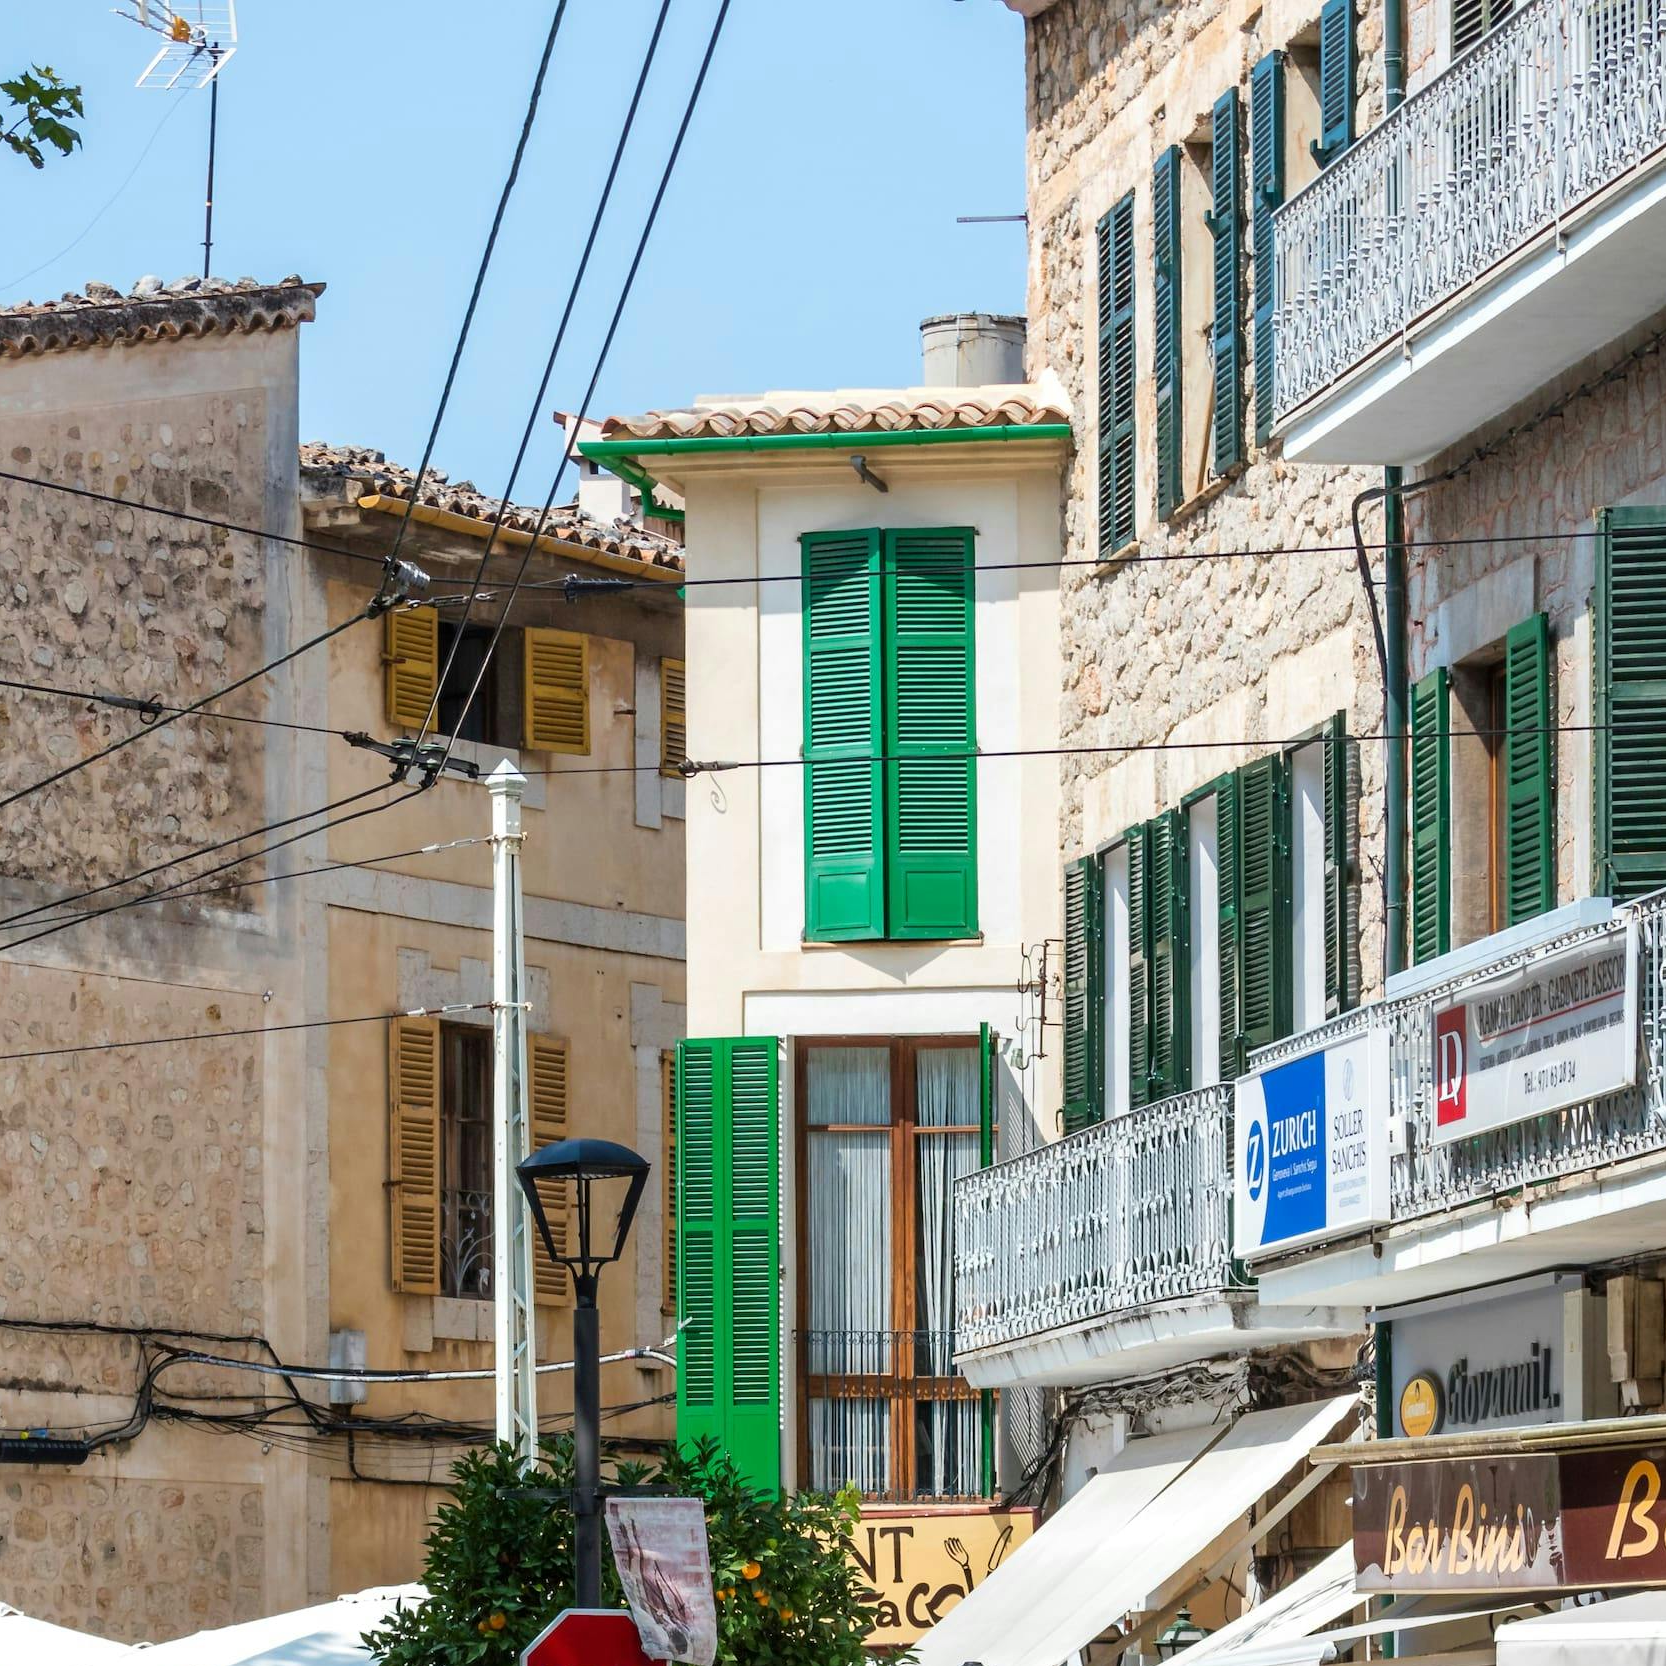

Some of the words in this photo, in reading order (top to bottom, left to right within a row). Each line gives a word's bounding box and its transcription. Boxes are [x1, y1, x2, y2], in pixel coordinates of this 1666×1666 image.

[1548, 967, 1590, 1012] GABINETE
[1272, 1109, 1317, 1158] ZURICH
[1332, 1141, 1367, 1175] SANCHIS
[1383, 1485, 1444, 1576] Bar
[1448, 1483, 1528, 1576] Bini
